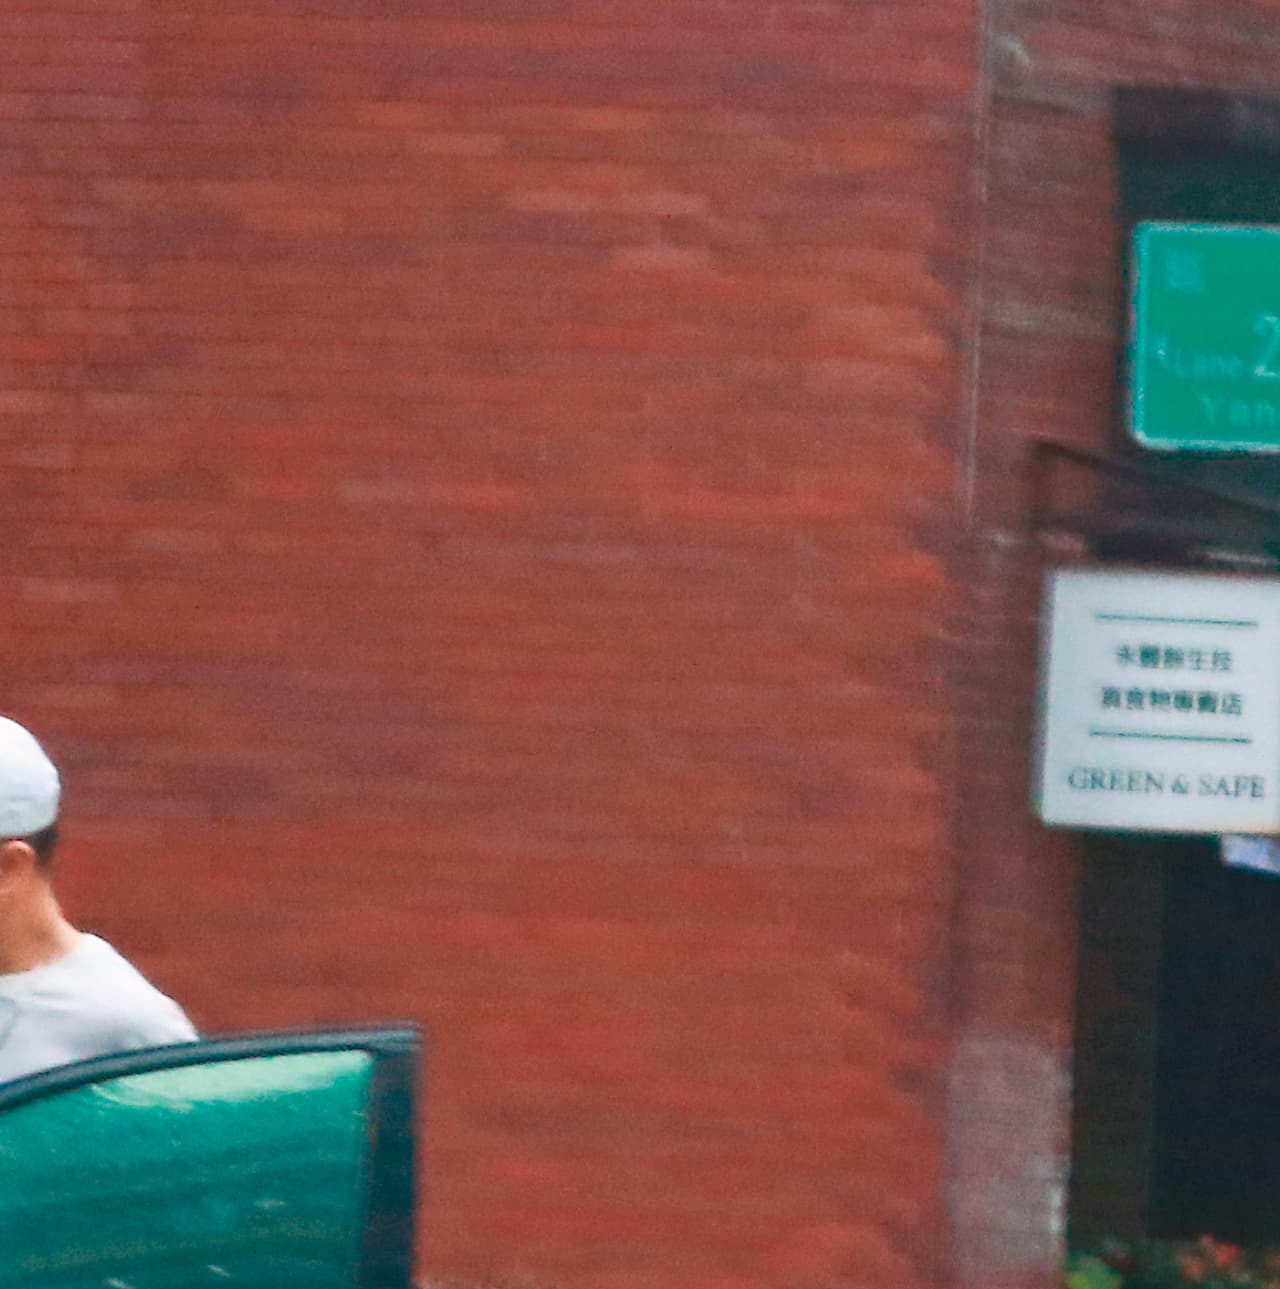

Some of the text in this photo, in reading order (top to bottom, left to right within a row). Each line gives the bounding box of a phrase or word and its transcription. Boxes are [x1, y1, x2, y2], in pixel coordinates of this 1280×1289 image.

[1067, 766, 1266, 798] GREEN & SAFE
